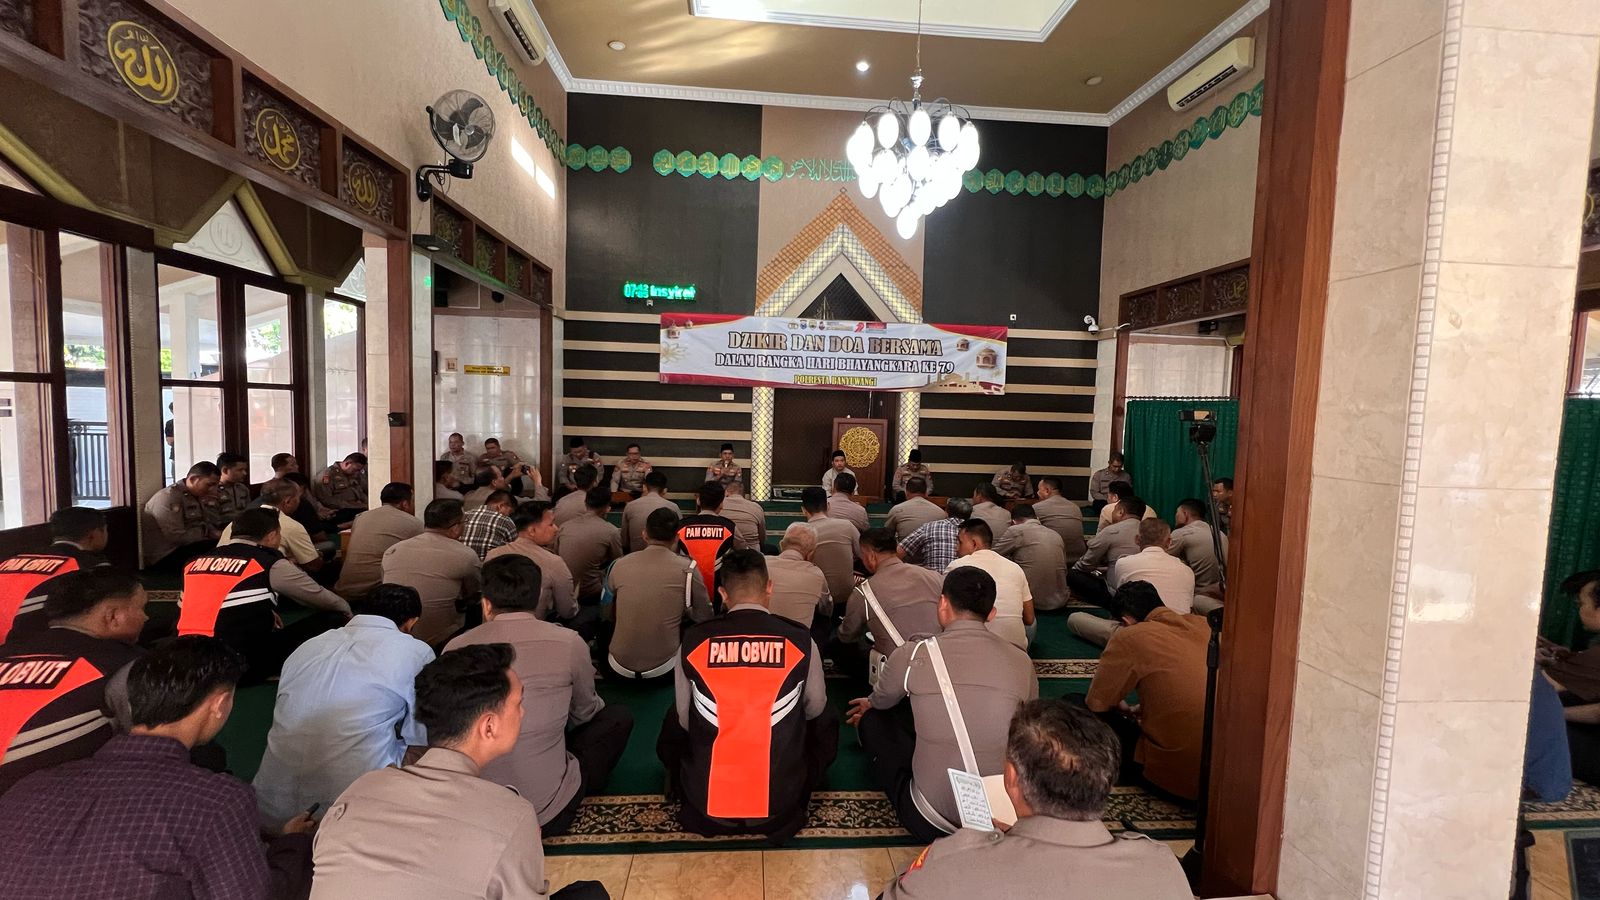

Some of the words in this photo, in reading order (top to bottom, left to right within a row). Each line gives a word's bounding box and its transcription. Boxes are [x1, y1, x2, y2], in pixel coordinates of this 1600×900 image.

[728, 331, 787, 350] DZIKIR
[791, 334, 825, 353] DAN
[828, 335, 864, 354] DOA
[868, 337, 943, 356] BERSAMA
[715, 353, 756, 367] DALAM
[757, 355, 803, 369] RANGKA
[806, 357, 836, 370] HARI
[837, 358, 919, 373] BHAYANGKARA
[920, 361, 937, 374] KE
[938, 361, 954, 374] 79
[794, 375, 829, 385] POLRESTA
[831, 376, 877, 387] BANYUWANGI
[686, 527, 701, 538] PAM
[701, 527, 723, 538] OBVIT
[190, 557, 215, 572] PAM
[210, 557, 248, 573] OBVIT
[709, 642, 739, 663] PAM
[741, 641, 783, 663] OBVIT
[0, 661, 72, 686] OBVIT
